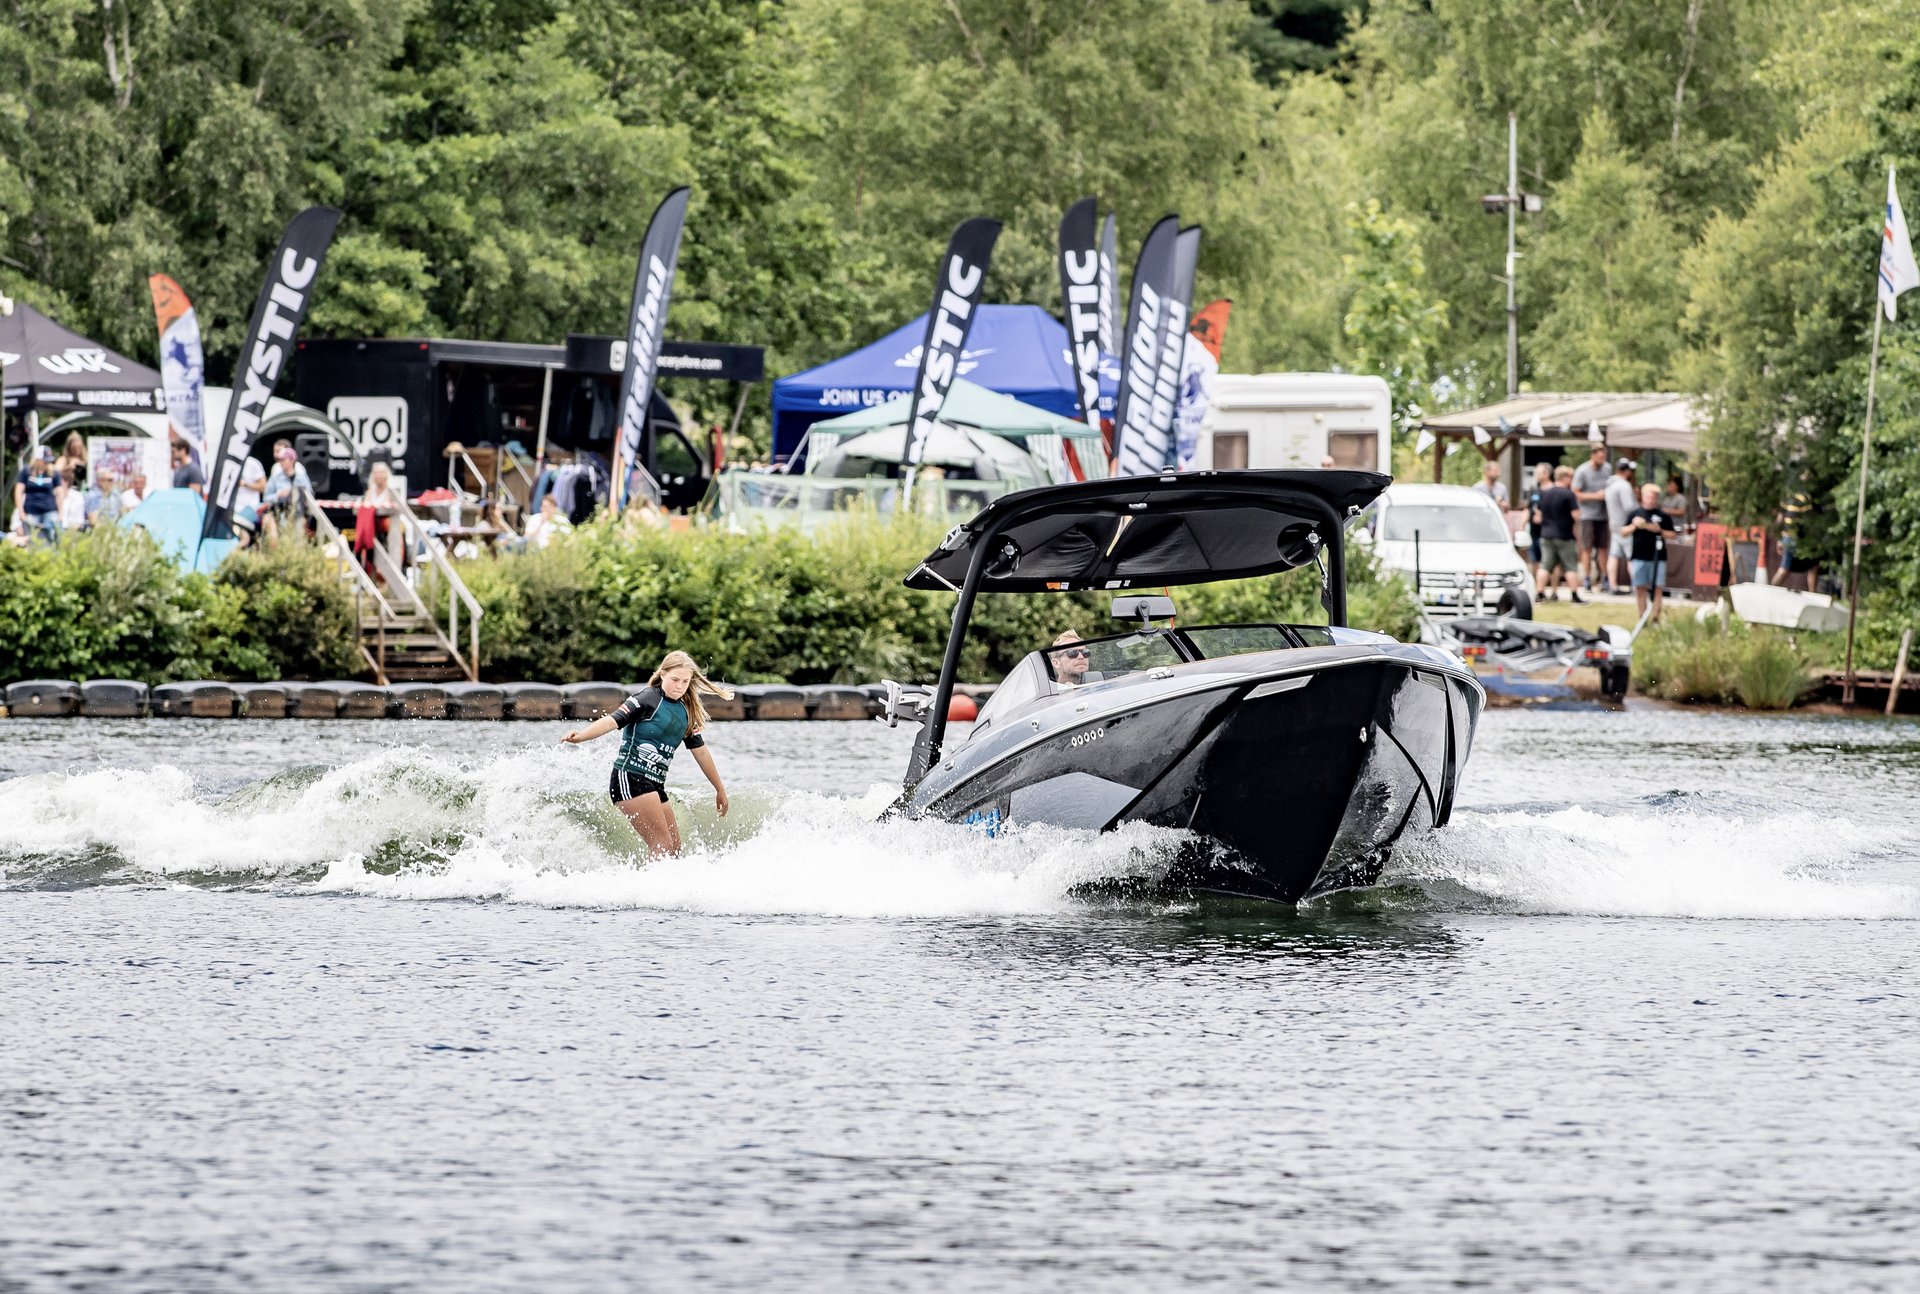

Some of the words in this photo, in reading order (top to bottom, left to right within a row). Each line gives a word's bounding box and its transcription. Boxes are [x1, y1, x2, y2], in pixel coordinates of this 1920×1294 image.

[226, 247, 317, 454] MYSTIC
[1065, 249, 1100, 431] YSTIC
[335, 407, 403, 444] bro!
[819, 388, 860, 406] JOIN
[862, 389, 886, 406] US
